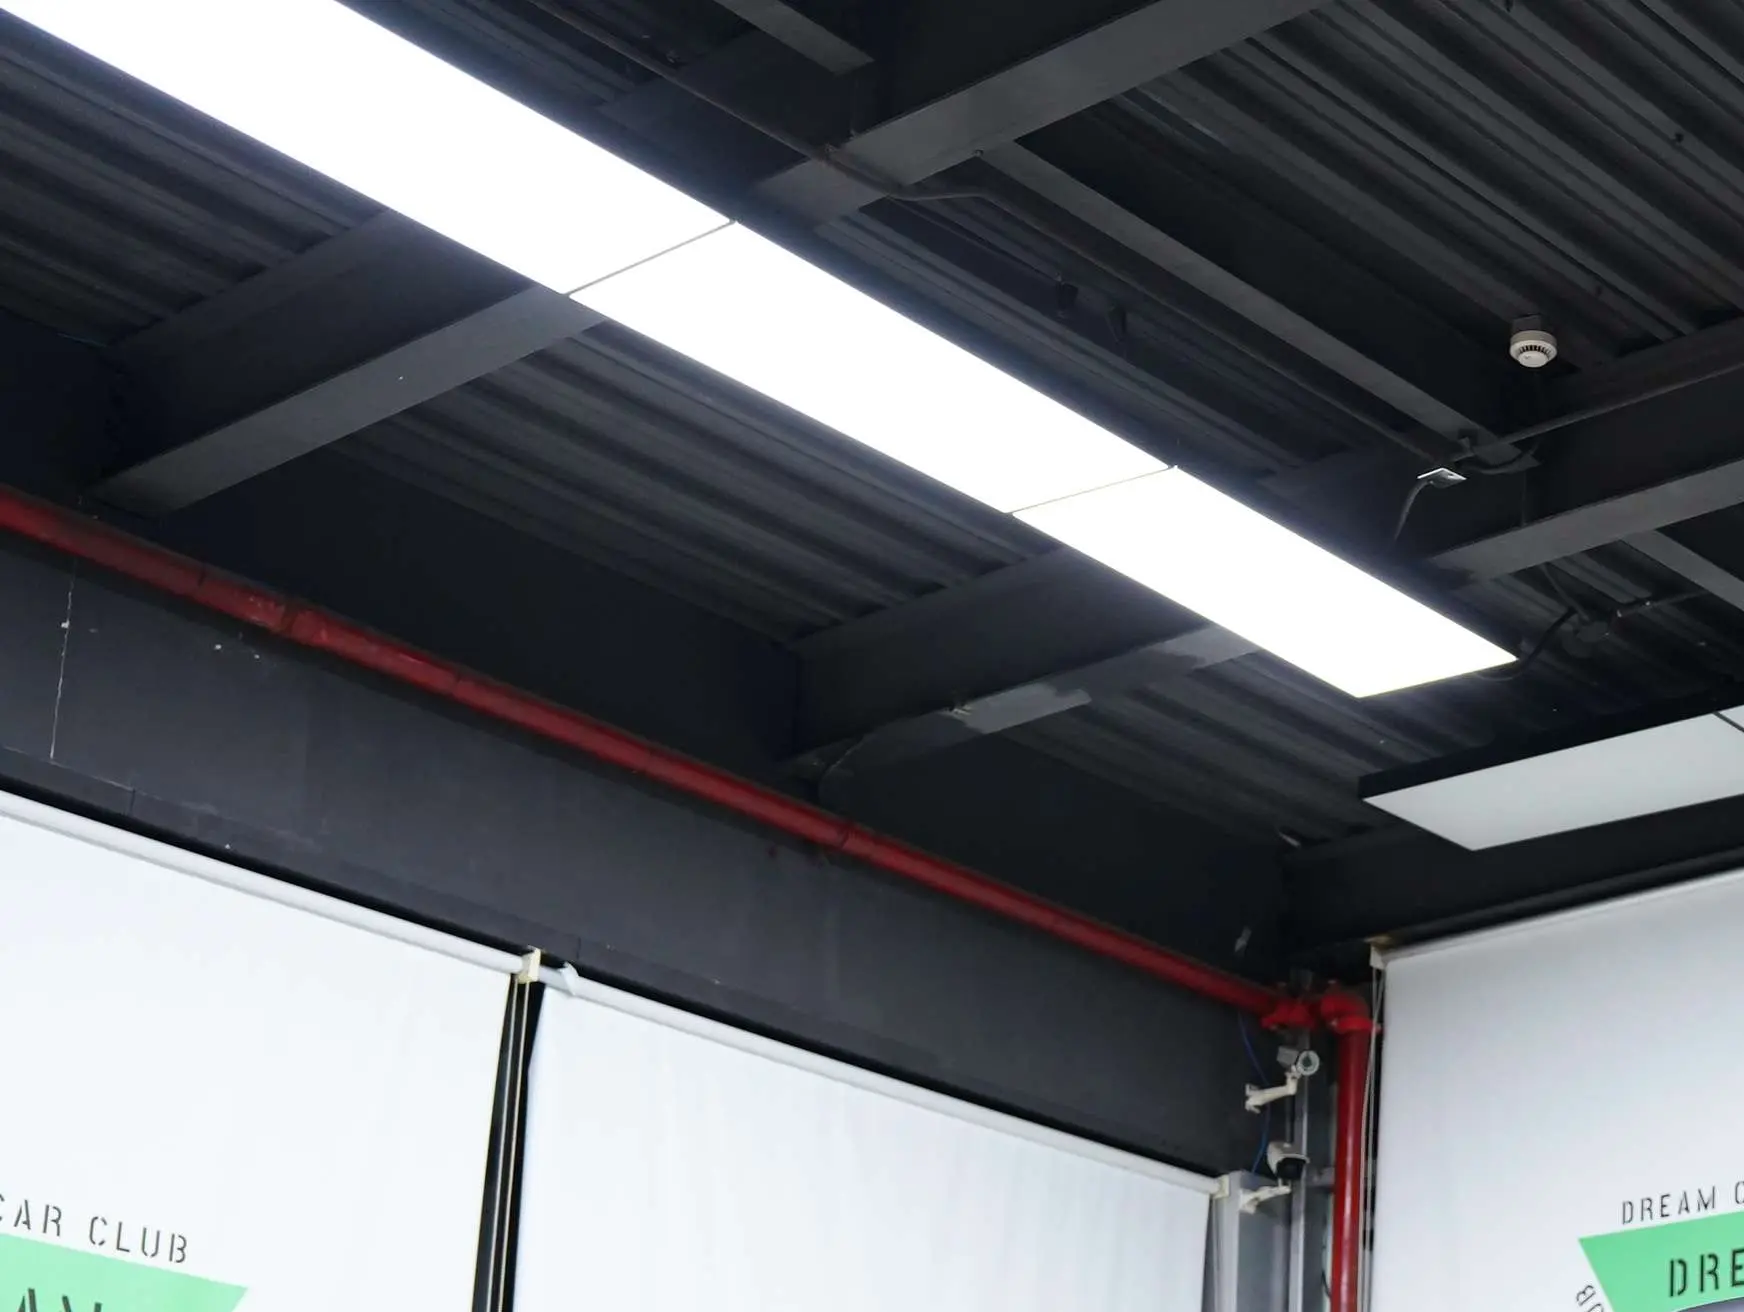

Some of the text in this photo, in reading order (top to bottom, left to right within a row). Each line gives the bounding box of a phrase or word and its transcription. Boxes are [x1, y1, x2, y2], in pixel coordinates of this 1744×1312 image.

[0, 1193, 187, 1264] AR CLUB
[1622, 1186, 1716, 1225] DREAM
